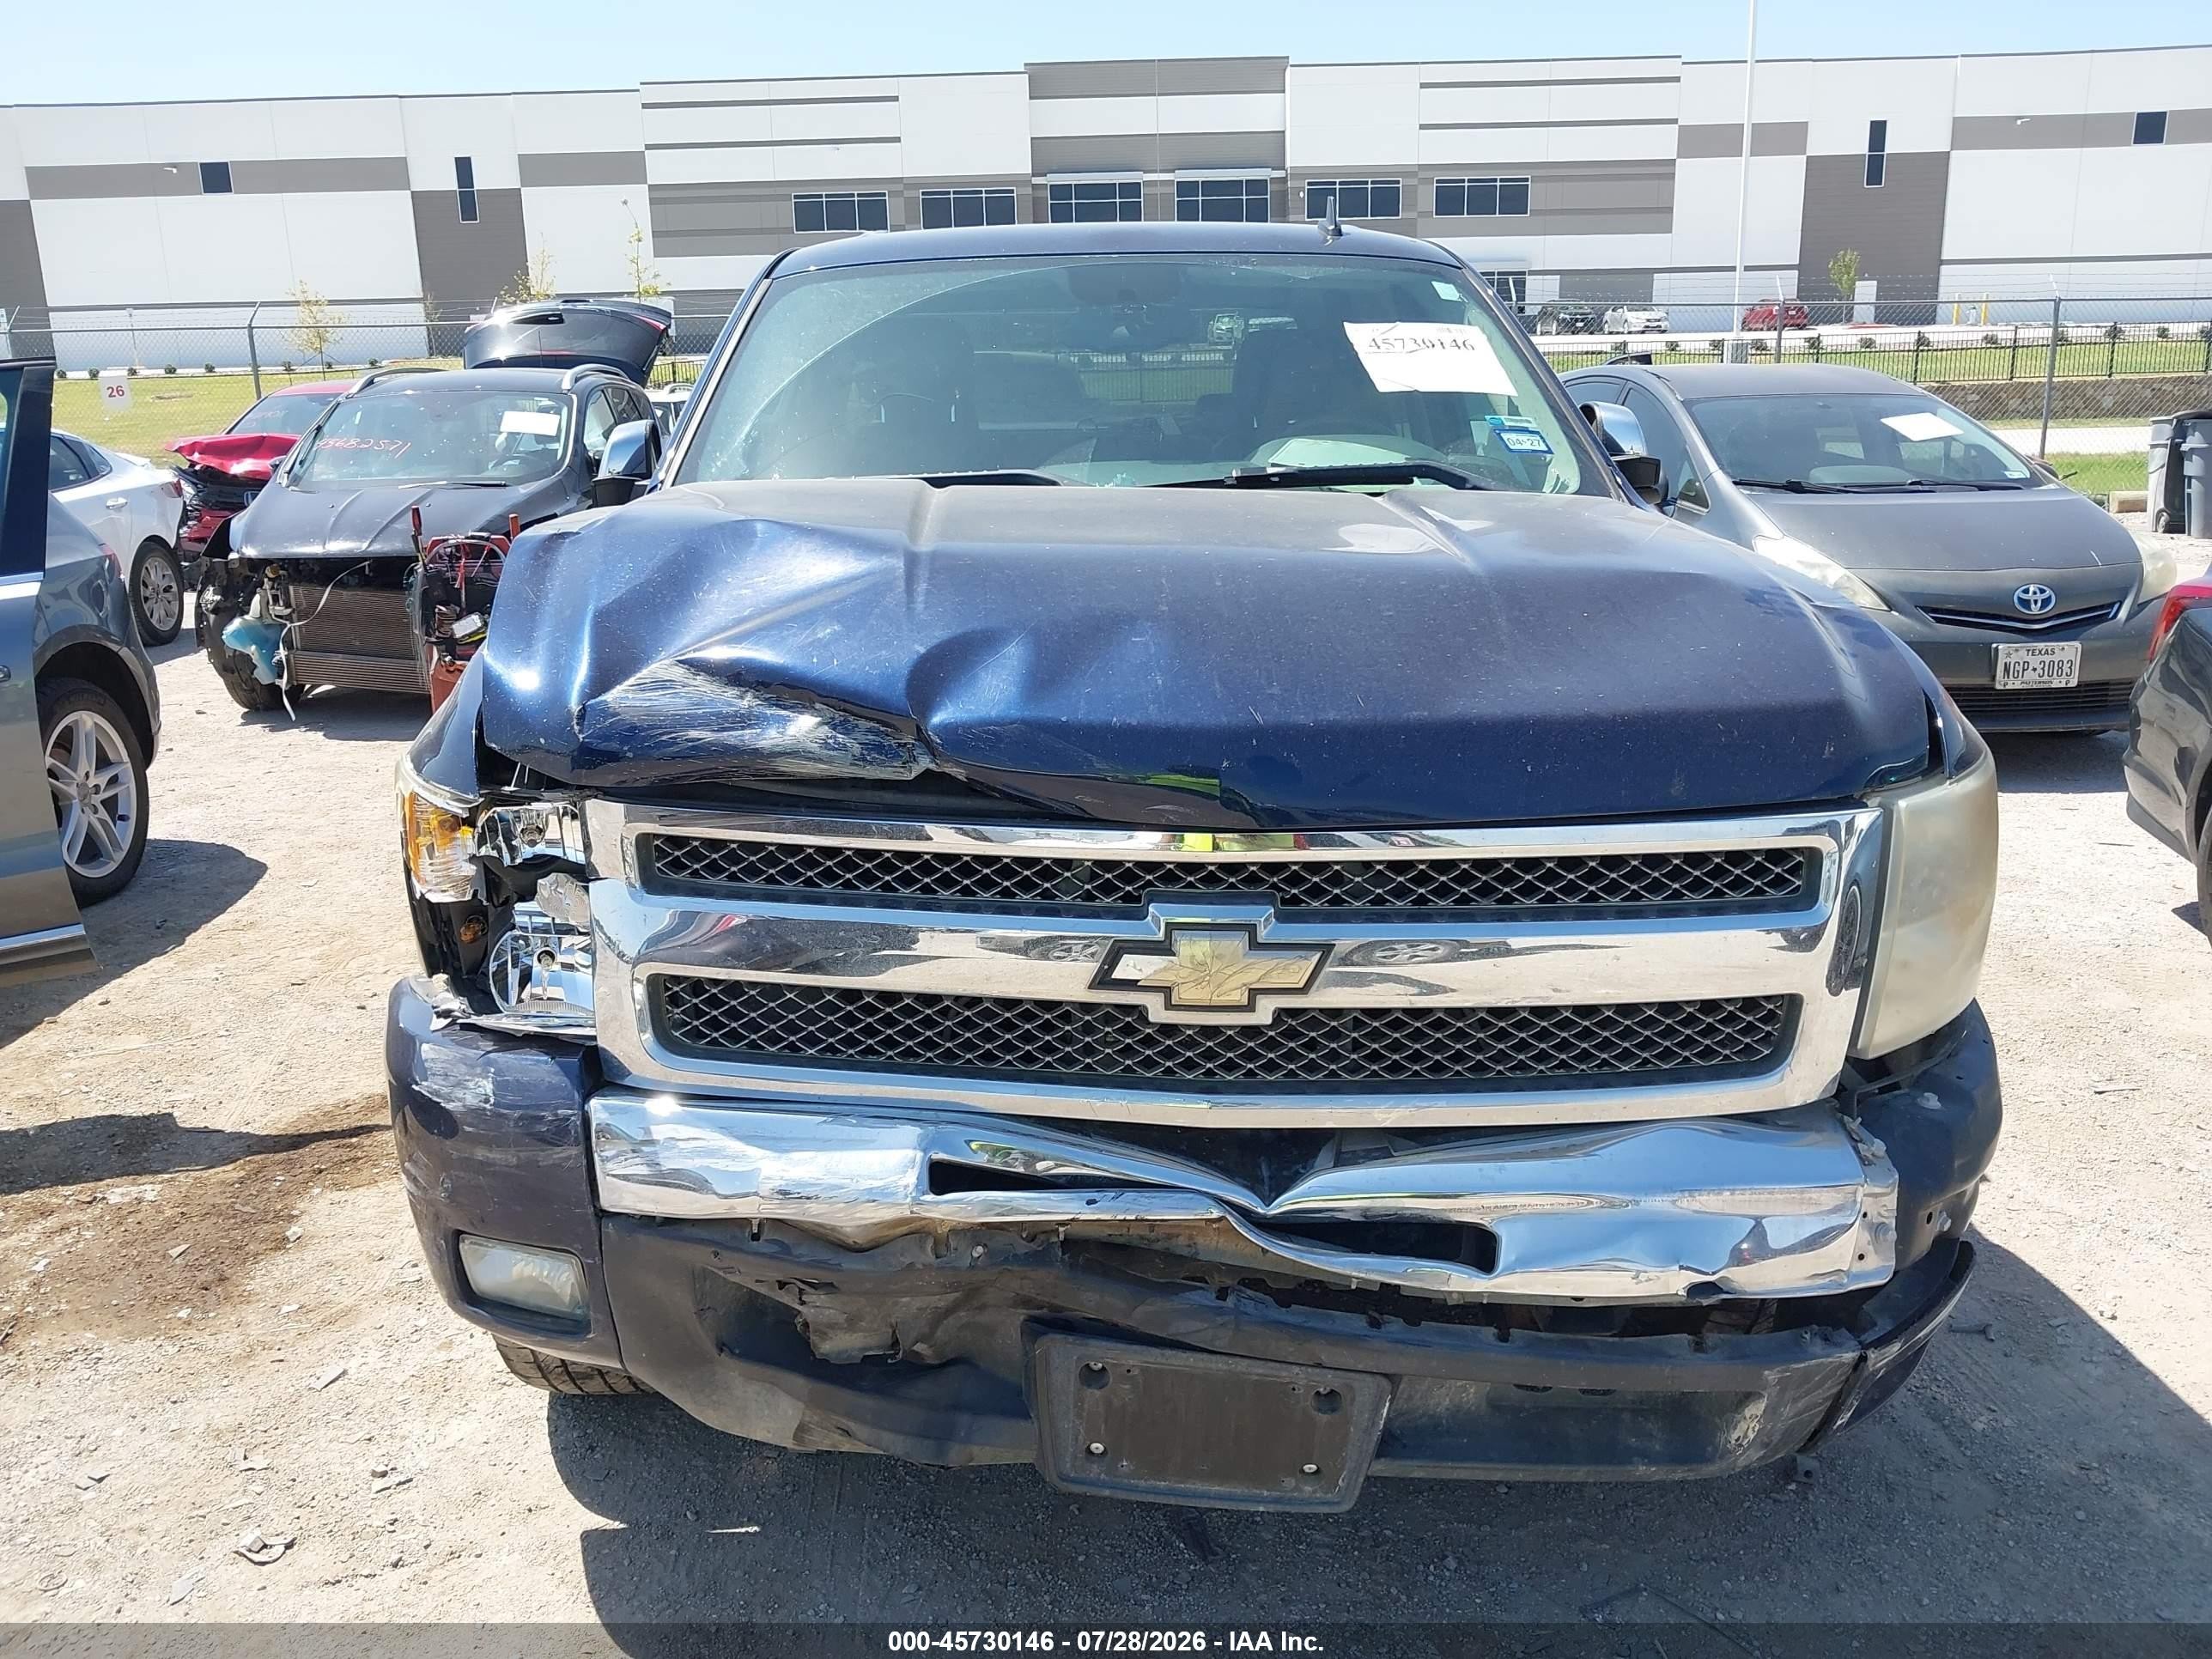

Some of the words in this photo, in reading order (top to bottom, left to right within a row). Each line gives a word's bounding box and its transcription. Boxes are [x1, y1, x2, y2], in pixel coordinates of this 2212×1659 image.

[1368, 337, 1476, 351] 45730146
[106, 386, 125, 398] 26
[2026, 647, 2057, 657] TEXAS
[2002, 660, 2030, 679] NGP
[2038, 659, 2074, 678] 3083
